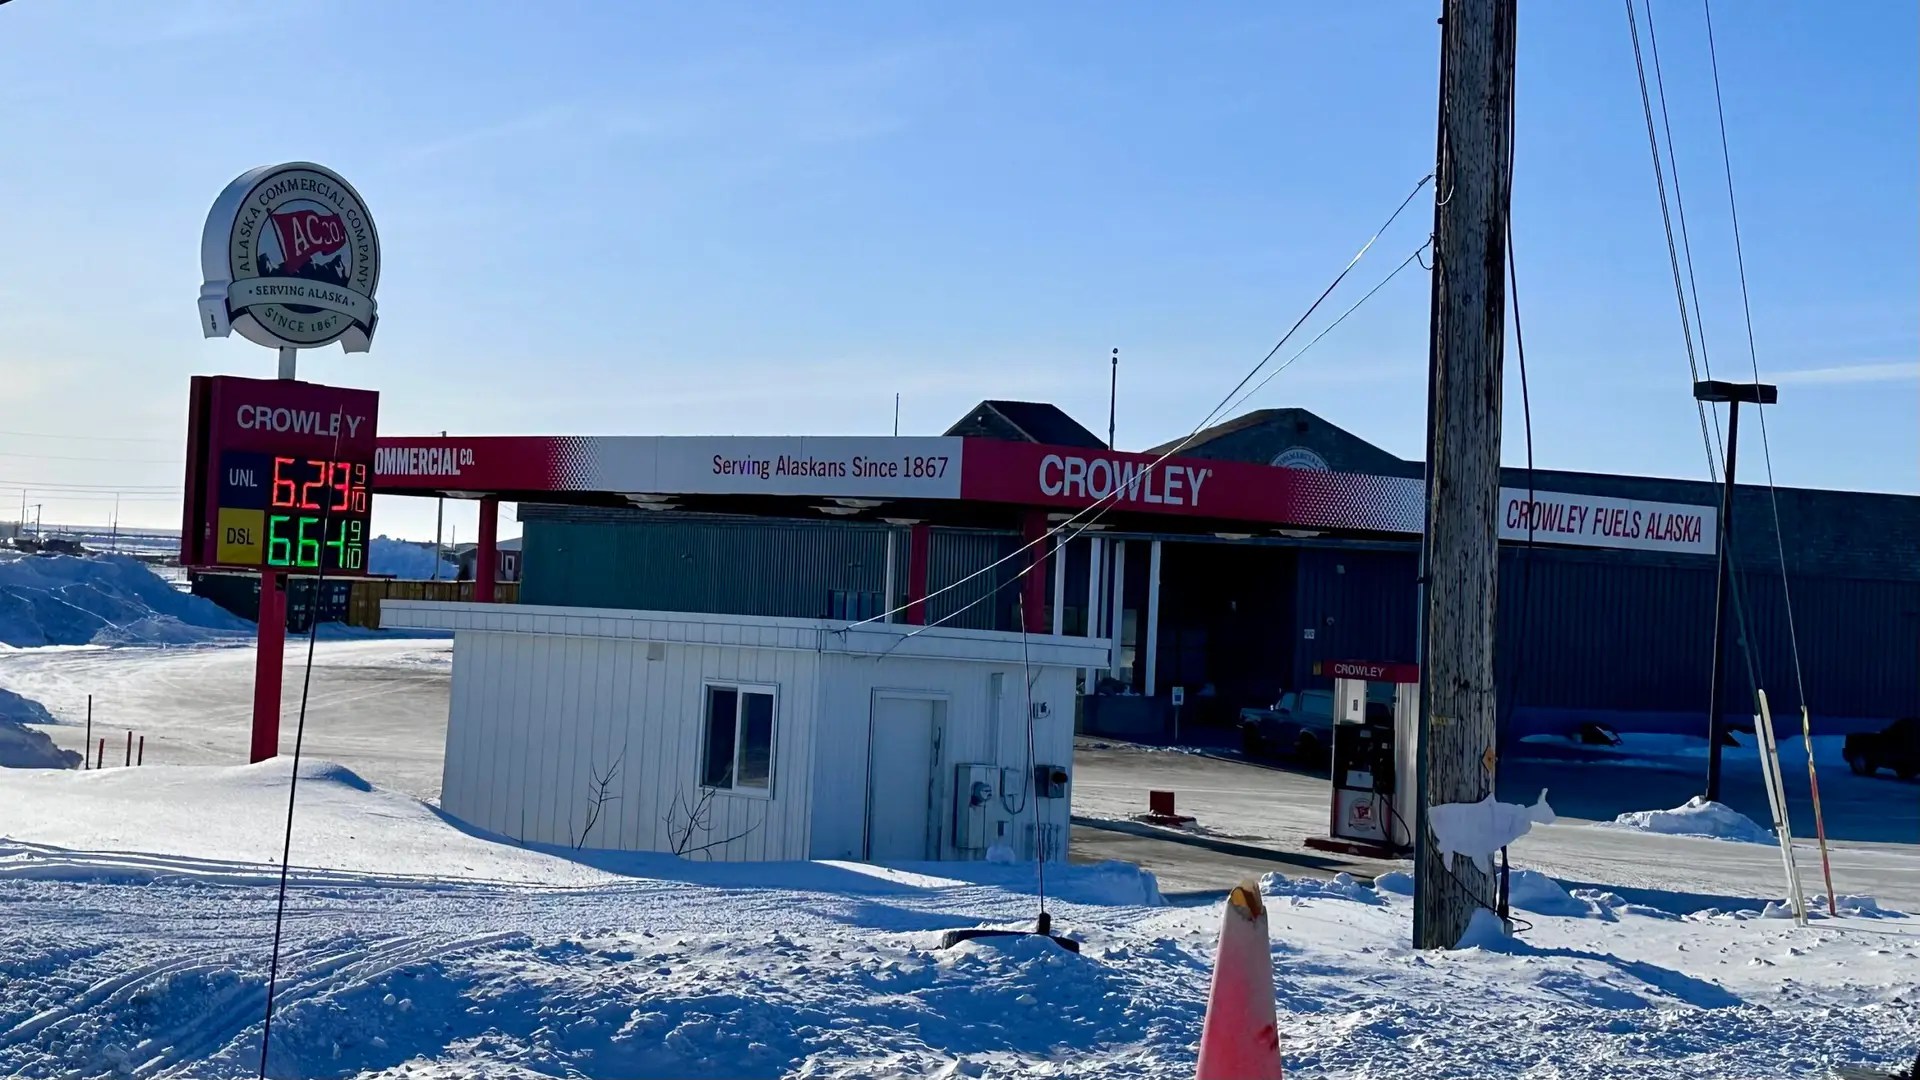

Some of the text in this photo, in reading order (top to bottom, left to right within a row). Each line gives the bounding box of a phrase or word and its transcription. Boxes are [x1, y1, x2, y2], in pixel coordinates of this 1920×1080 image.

[238, 178, 369, 288] ALASKA COMMERCIAL COMPANY
[255, 285, 349, 306] SERVING ALASKA
[265, 307, 338, 332] SINCE 1867
[237, 405, 361, 439] CROWLEY
[374, 447, 475, 476] OMMERCIAL CO.
[713, 454, 949, 479] Serving Alaskans Since 1867
[229, 468, 258, 487] UNL
[272, 457, 351, 511] 6.29
[1039, 454, 1207, 506] CROWLEY
[1507, 500, 1701, 543] CROWLEY FUELS ALASKA
[227, 527, 254, 545] DSL
[1334, 663, 1385, 677] CROWLEY
